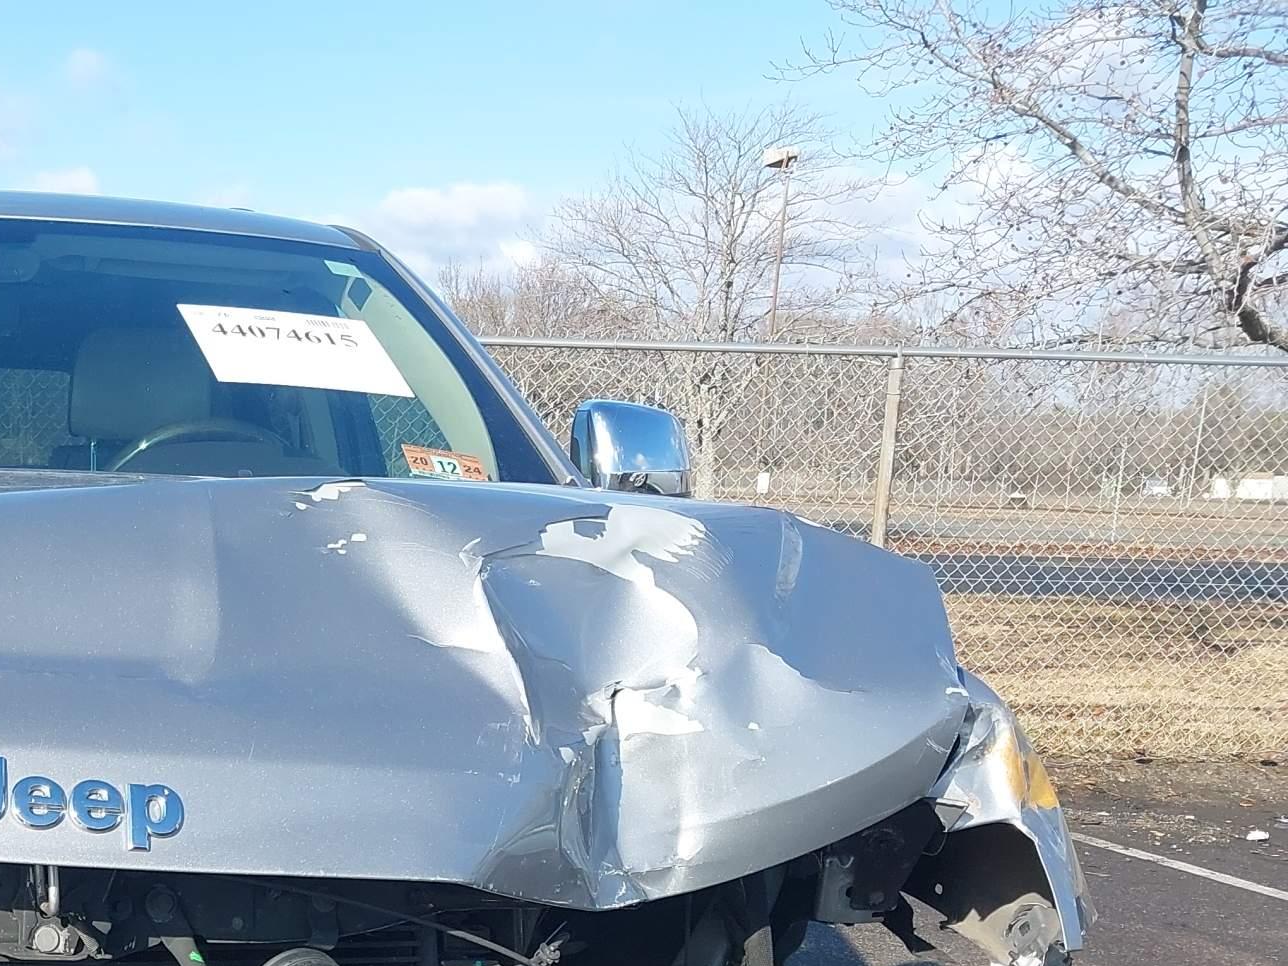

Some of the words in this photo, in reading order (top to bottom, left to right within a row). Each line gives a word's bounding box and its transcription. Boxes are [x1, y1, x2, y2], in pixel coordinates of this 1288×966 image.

[212, 322, 359, 348] 44074615
[411, 456, 429, 466] 20
[437, 460, 460, 475] 12
[463, 464, 482, 475] 24
